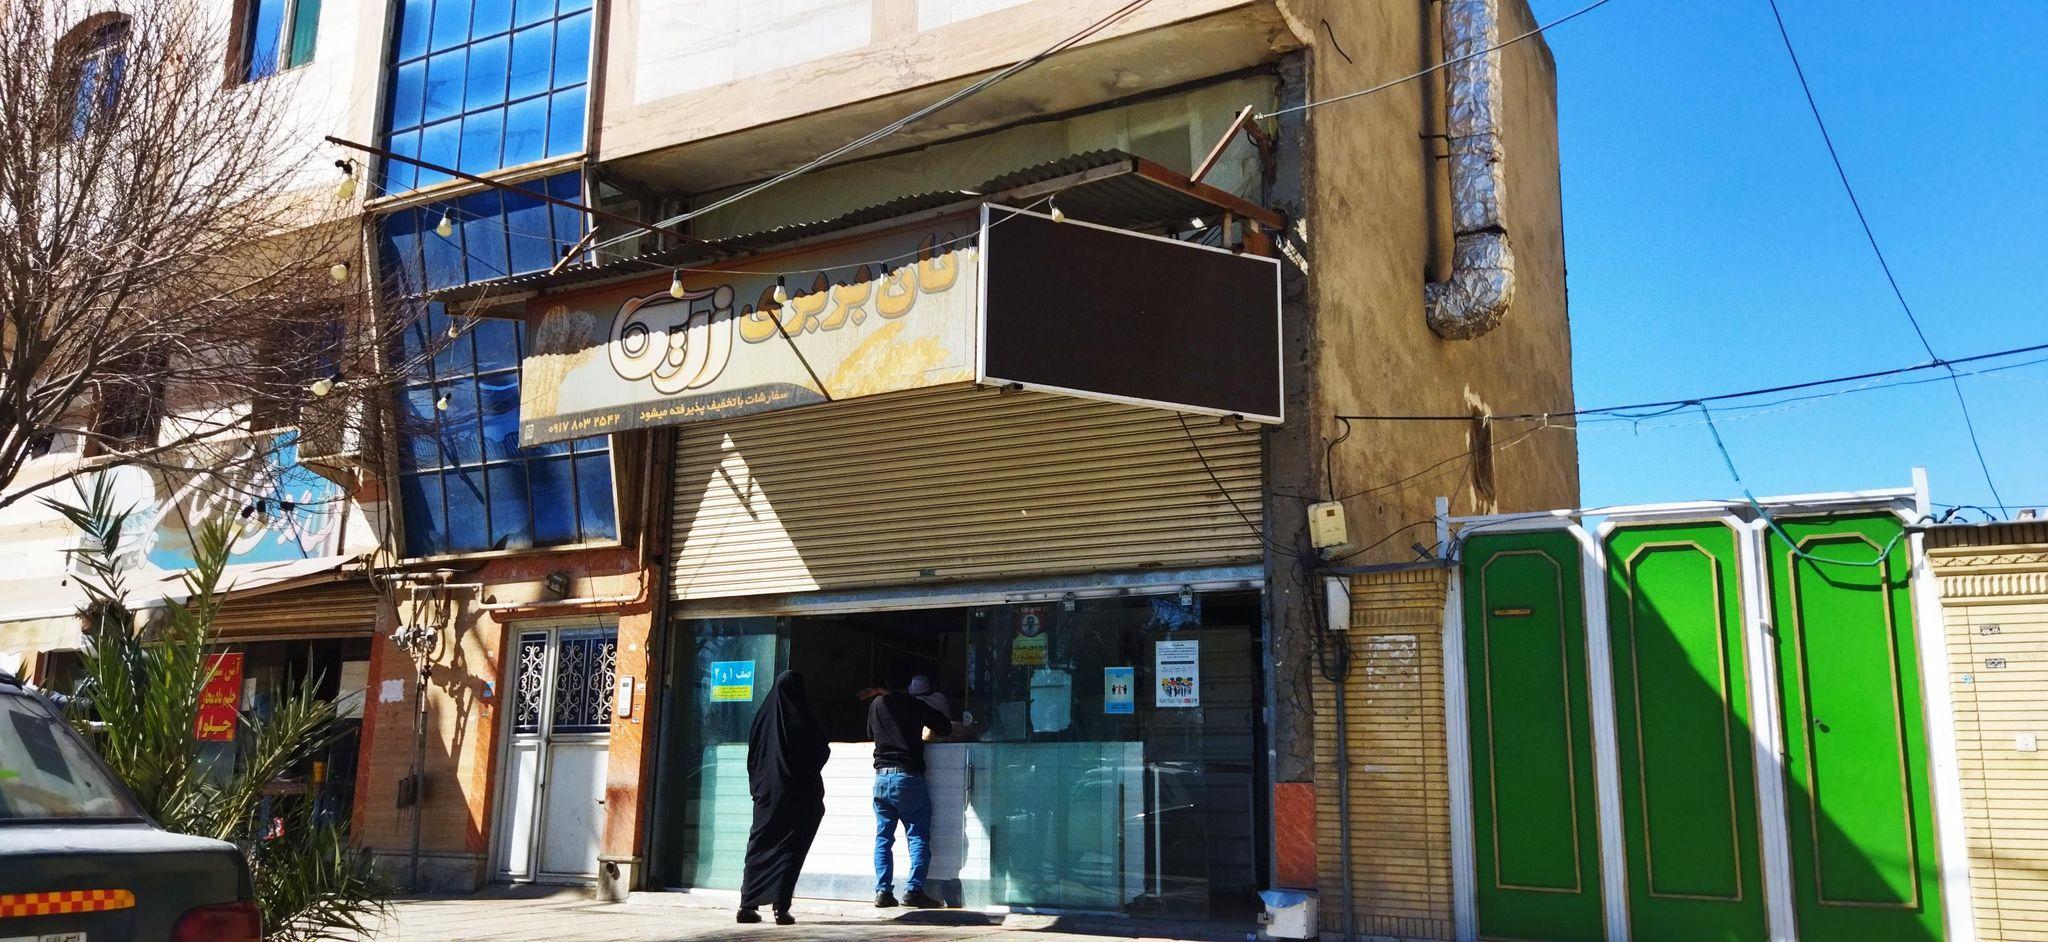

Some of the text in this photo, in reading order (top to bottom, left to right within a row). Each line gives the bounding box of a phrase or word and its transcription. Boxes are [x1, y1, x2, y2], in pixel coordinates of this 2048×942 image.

[876, 231, 959, 320] نان
[738, 264, 872, 344] بربری
[745, 389, 789, 405] سفارشات
[639, 407, 668, 422] میشود
[670, 402, 705, 416] پذیرفته
[721, 672, 727, 683] و
[736, 667, 752, 679] صف
